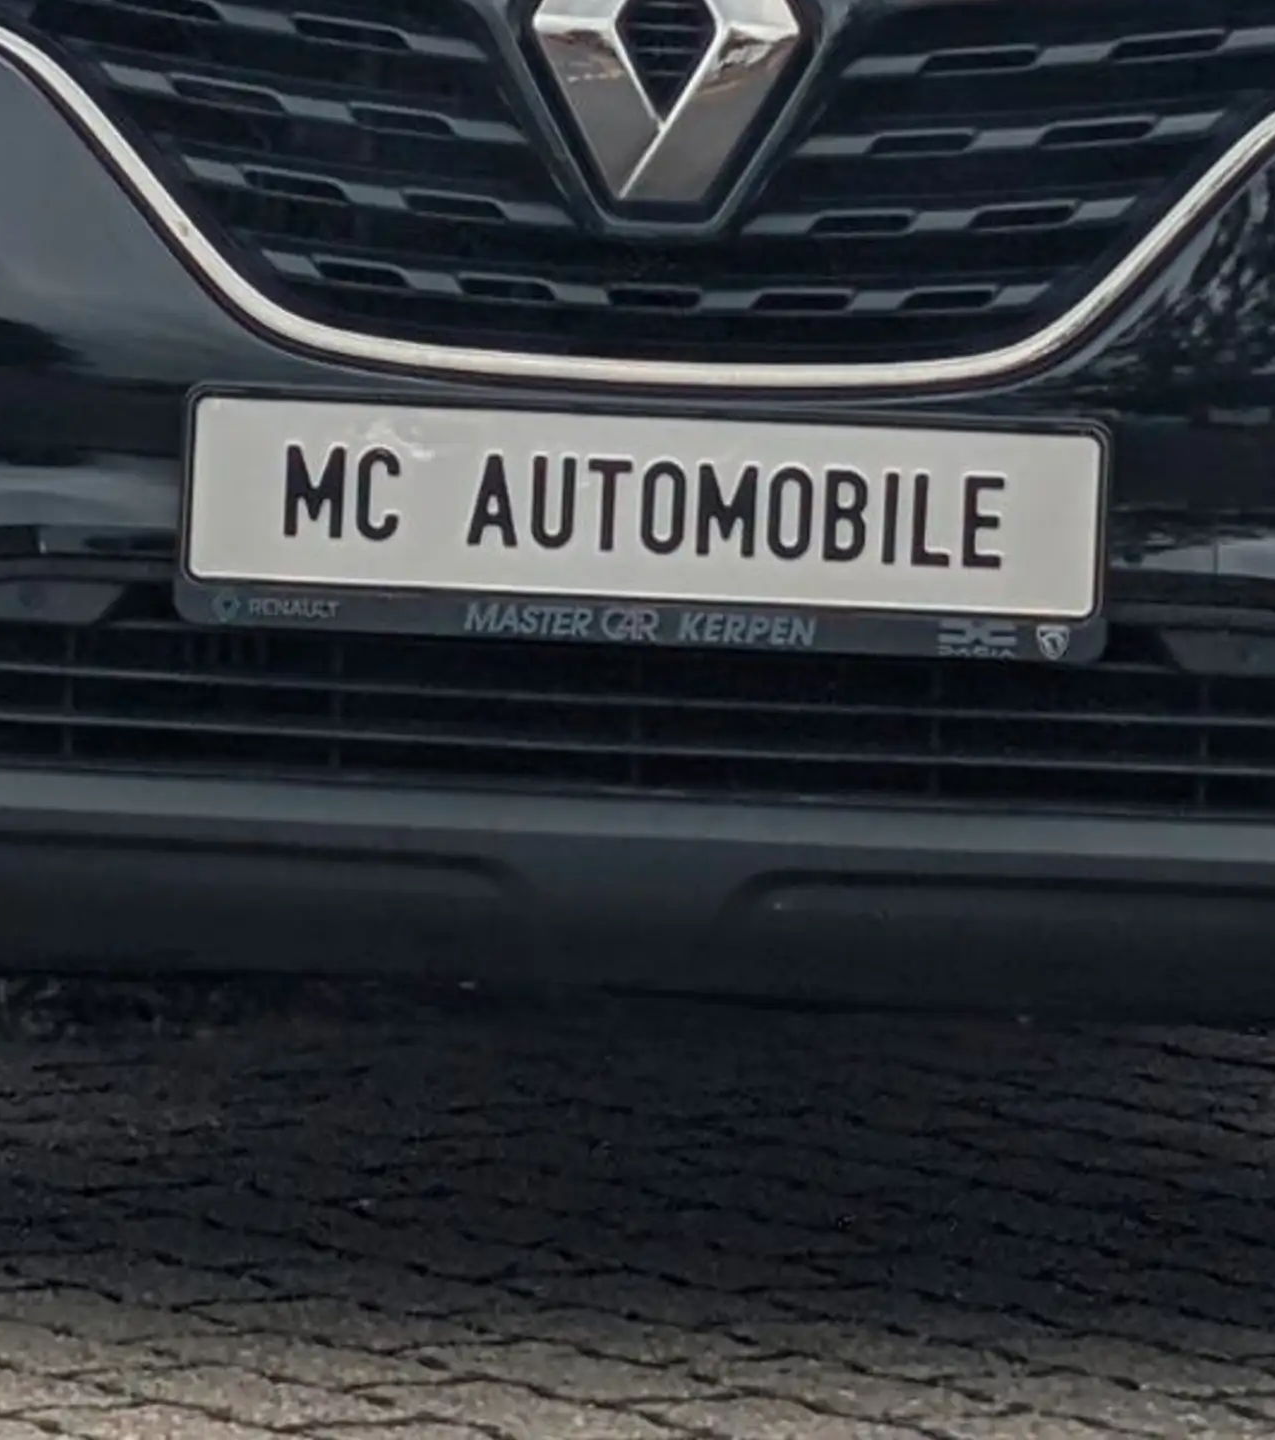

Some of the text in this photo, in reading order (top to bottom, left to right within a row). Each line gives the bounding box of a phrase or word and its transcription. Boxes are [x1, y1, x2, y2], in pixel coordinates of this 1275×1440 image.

[282, 443, 1007, 569] MC AUTOMOBILE
[248, 597, 341, 619] RENAULT
[463, 602, 818, 647] MASTER CAR KERPEN
